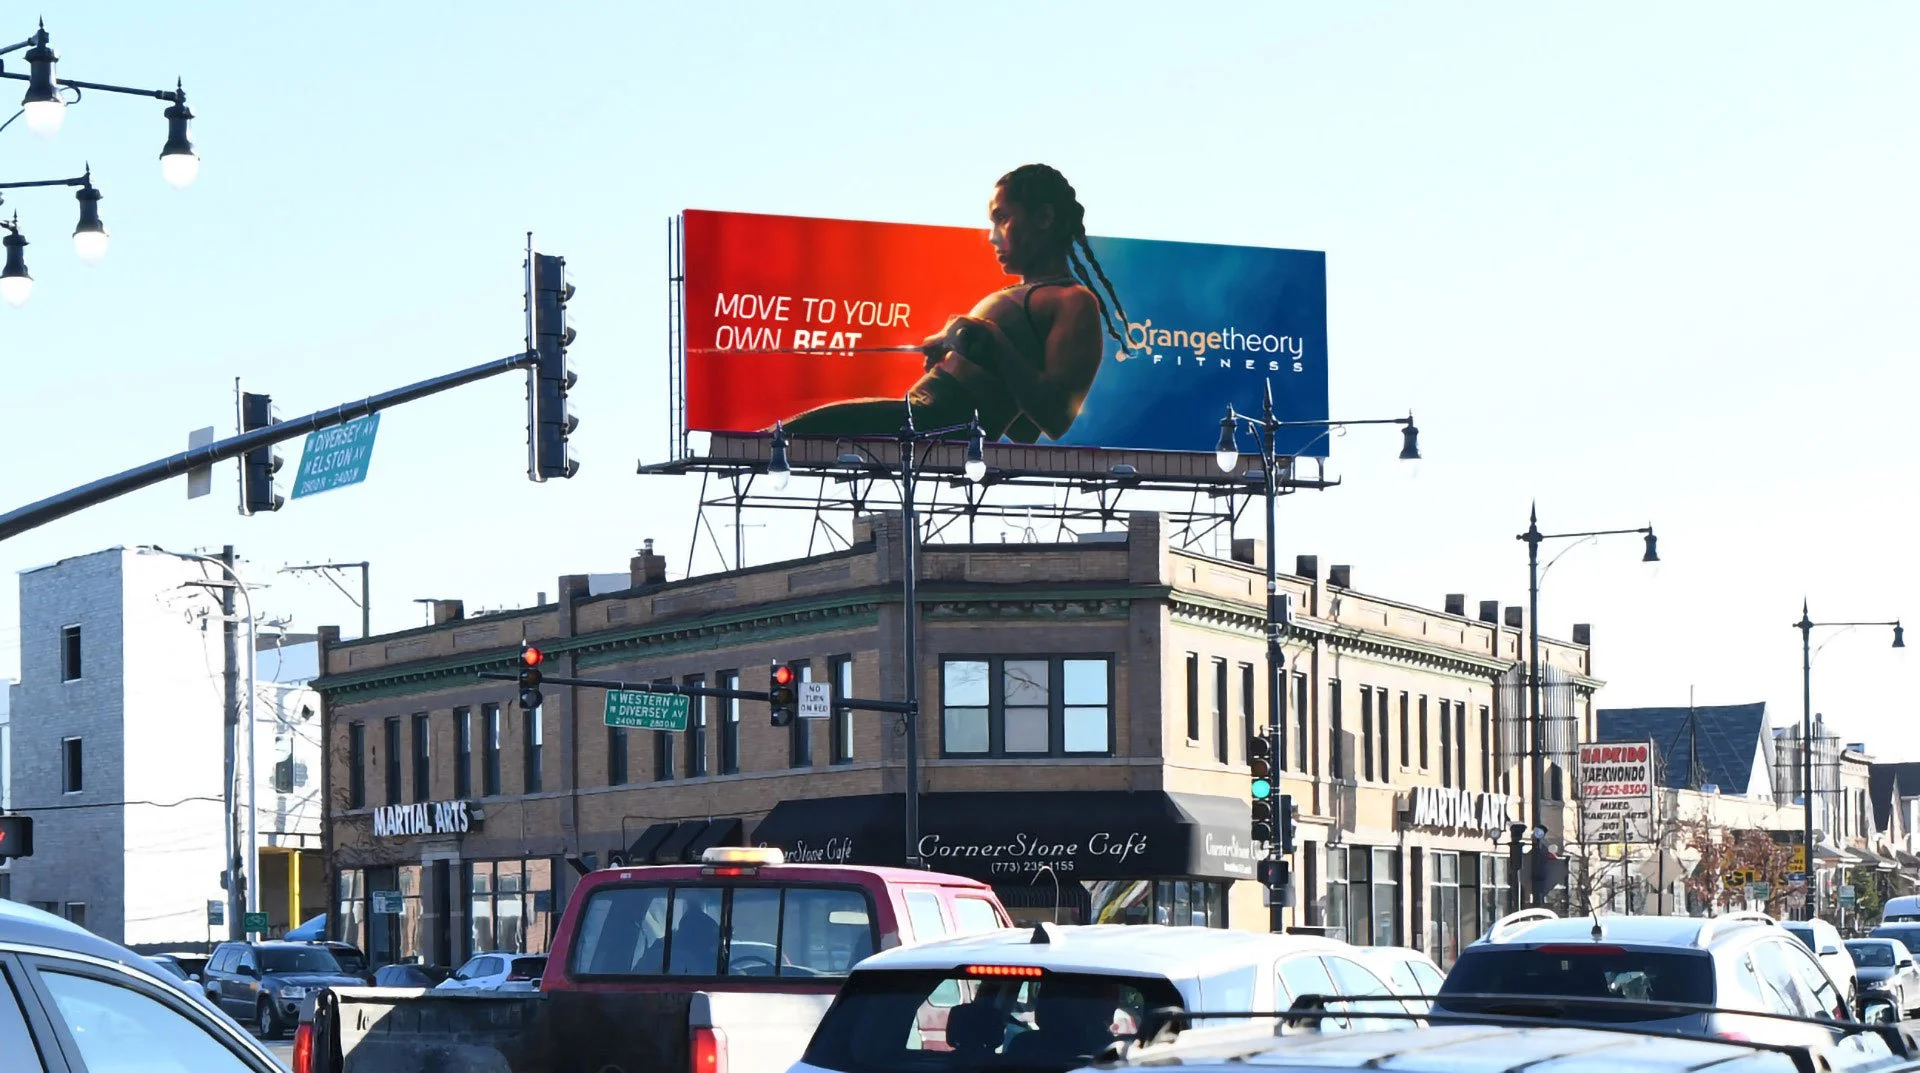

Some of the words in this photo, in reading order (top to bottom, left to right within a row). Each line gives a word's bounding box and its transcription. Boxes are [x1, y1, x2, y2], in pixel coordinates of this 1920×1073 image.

[714, 292, 792, 321] MOVE
[802, 297, 836, 323] TO
[843, 300, 911, 328] YOUR
[715, 325, 782, 350] OWN
[793, 329, 862, 356] BEAT
[1153, 354, 1304, 373] FITNESS
[314, 423, 361, 453] DIVERSEY
[362, 420, 376, 437] AV
[311, 446, 353, 475] ELSTON
[352, 445, 366, 461] AV
[809, 685, 821, 693] NO
[610, 693, 617, 702] N
[619, 693, 671, 707] WESTERN
[672, 698, 685, 707] AV
[800, 704, 812, 712] ON
[618, 705, 669, 719] DIVERSEY
[671, 711, 684, 719] AV
[1580, 746, 1648, 765] HAPKIDO
[1582, 765, 1646, 783] TAEKWONDO
[1414, 786, 1478, 829] MARTIAL
[1599, 801, 1631, 811] MIXED
[374, 803, 432, 837] MARTIAL
[435, 801, 469, 833] ARTS
[826, 837, 852, 864] Café
[918, 832, 1078, 858] CornerStone
[1088, 832, 1148, 864] Café
[991, 861, 1021, 875] (773)
